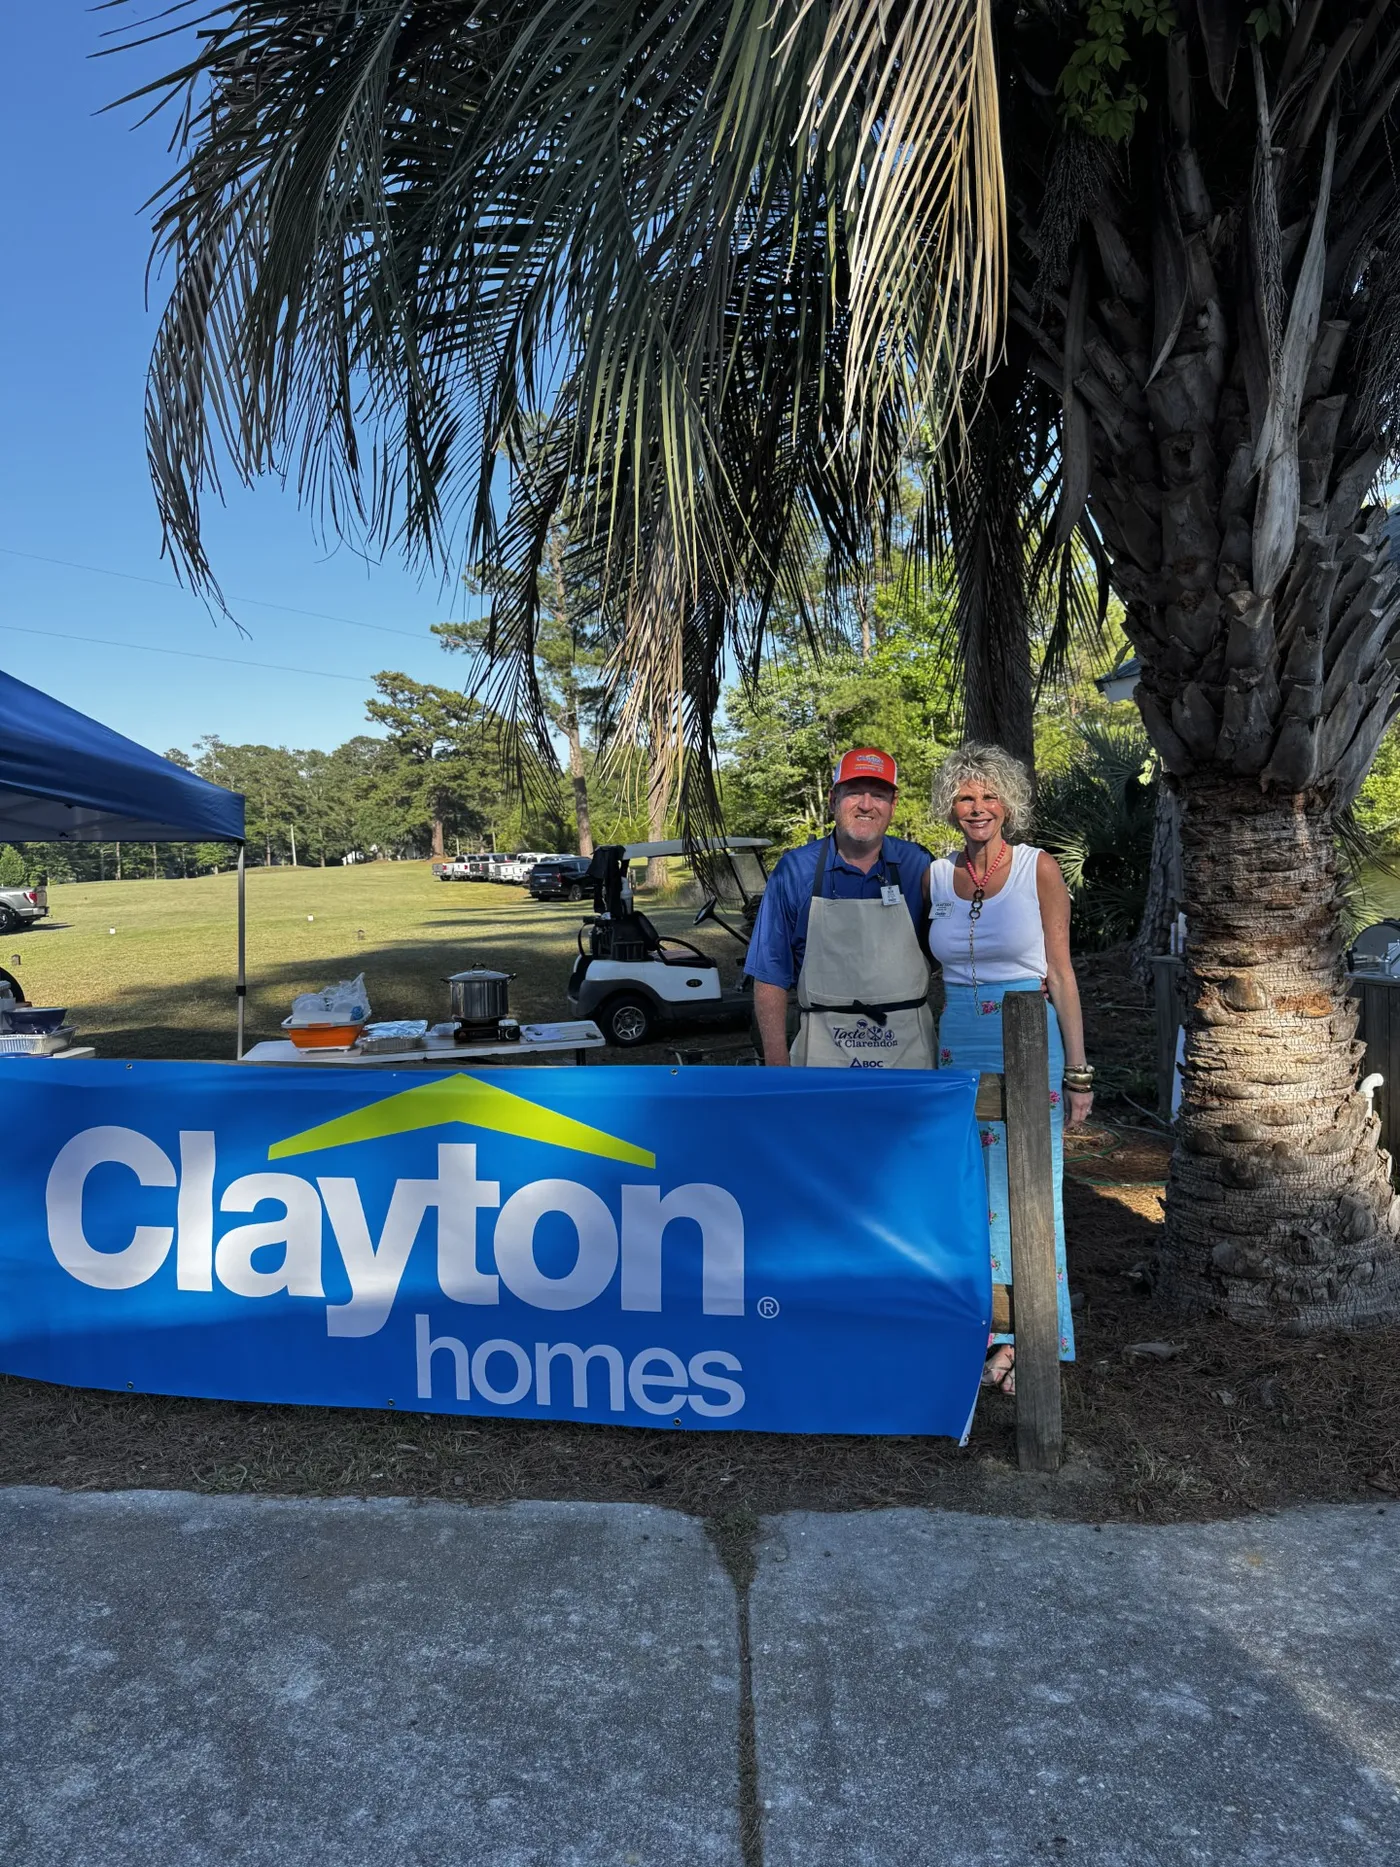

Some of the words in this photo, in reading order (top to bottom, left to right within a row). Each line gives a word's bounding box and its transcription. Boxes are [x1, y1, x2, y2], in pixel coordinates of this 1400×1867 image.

[833, 1027, 866, 1039] Taste
[844, 1039, 898, 1048] Clarendon
[862, 1060, 884, 1068] BOC
[45, 1125, 745, 1338] Clayton
[415, 1313, 746, 1418] homes
